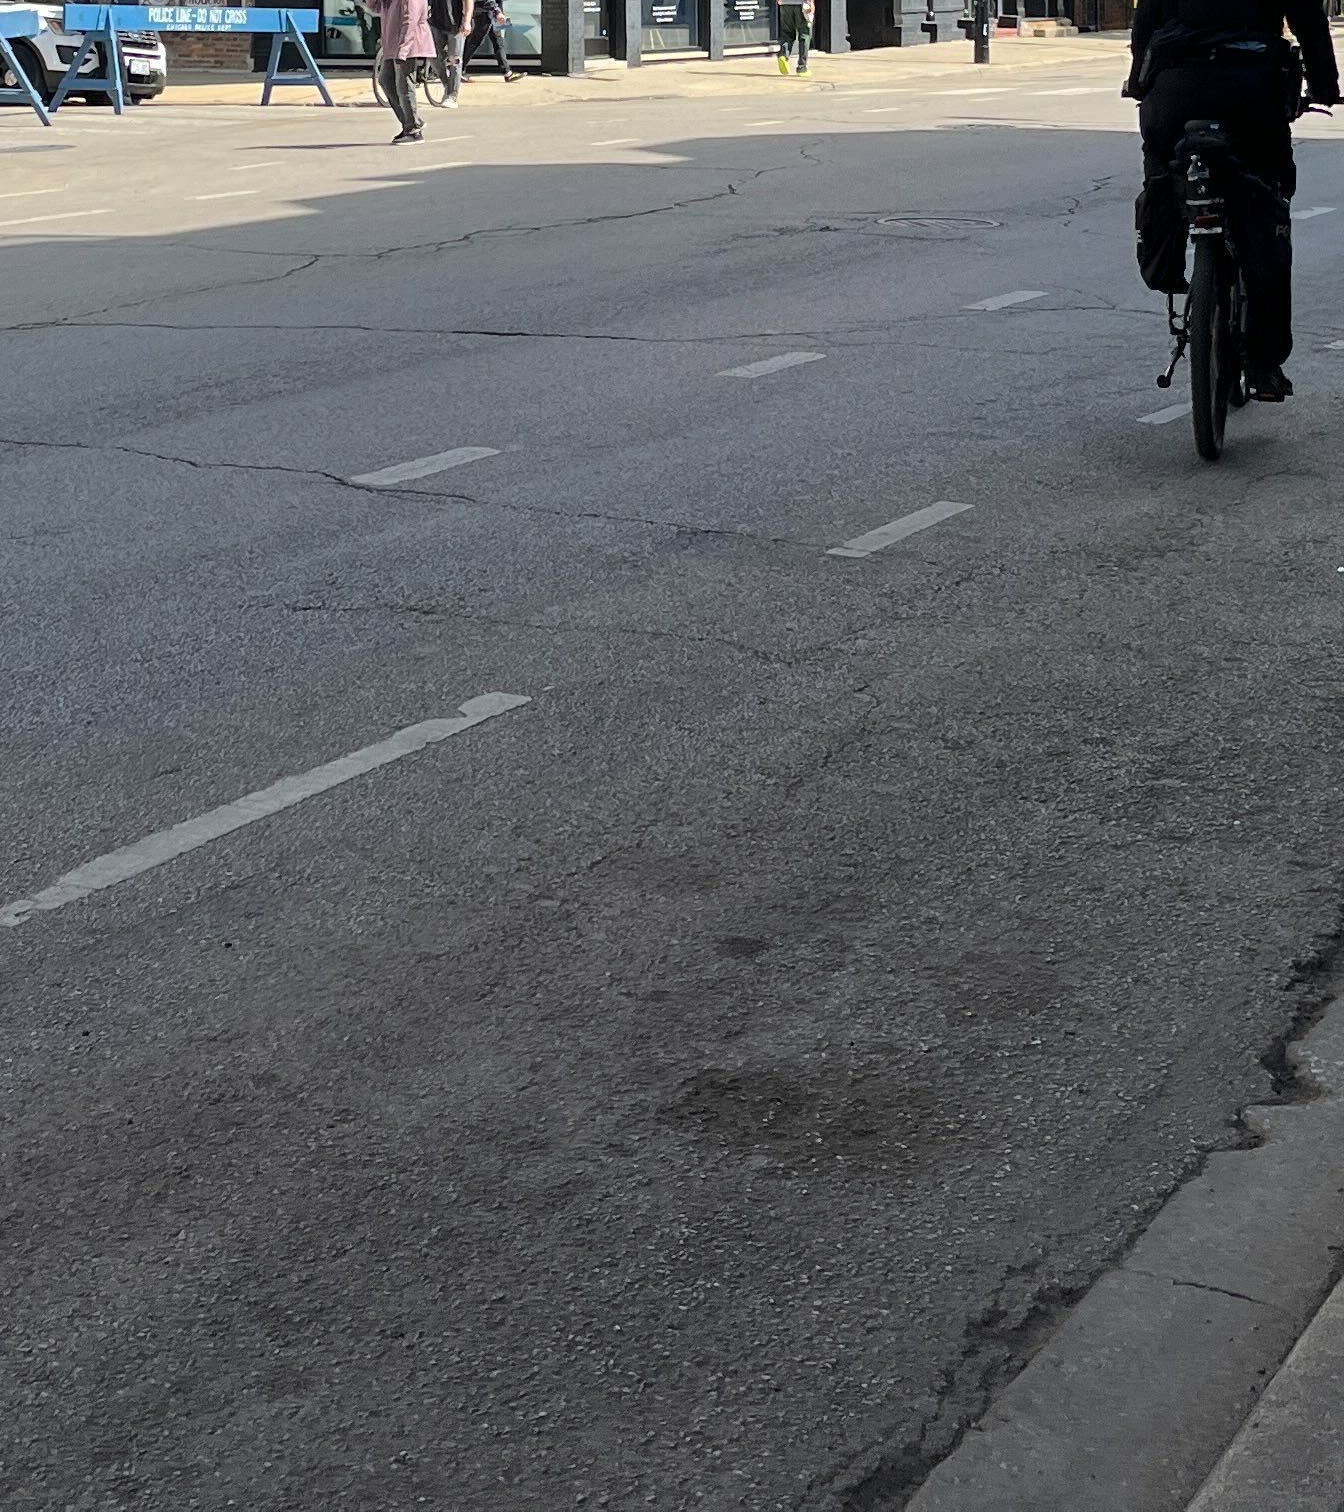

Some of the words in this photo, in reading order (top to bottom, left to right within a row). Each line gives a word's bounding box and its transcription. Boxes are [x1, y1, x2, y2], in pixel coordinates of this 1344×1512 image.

[149, 7, 174, 23] POLICE
[209, 9, 223, 23] NOT
[224, 10, 247, 25] CROSS
